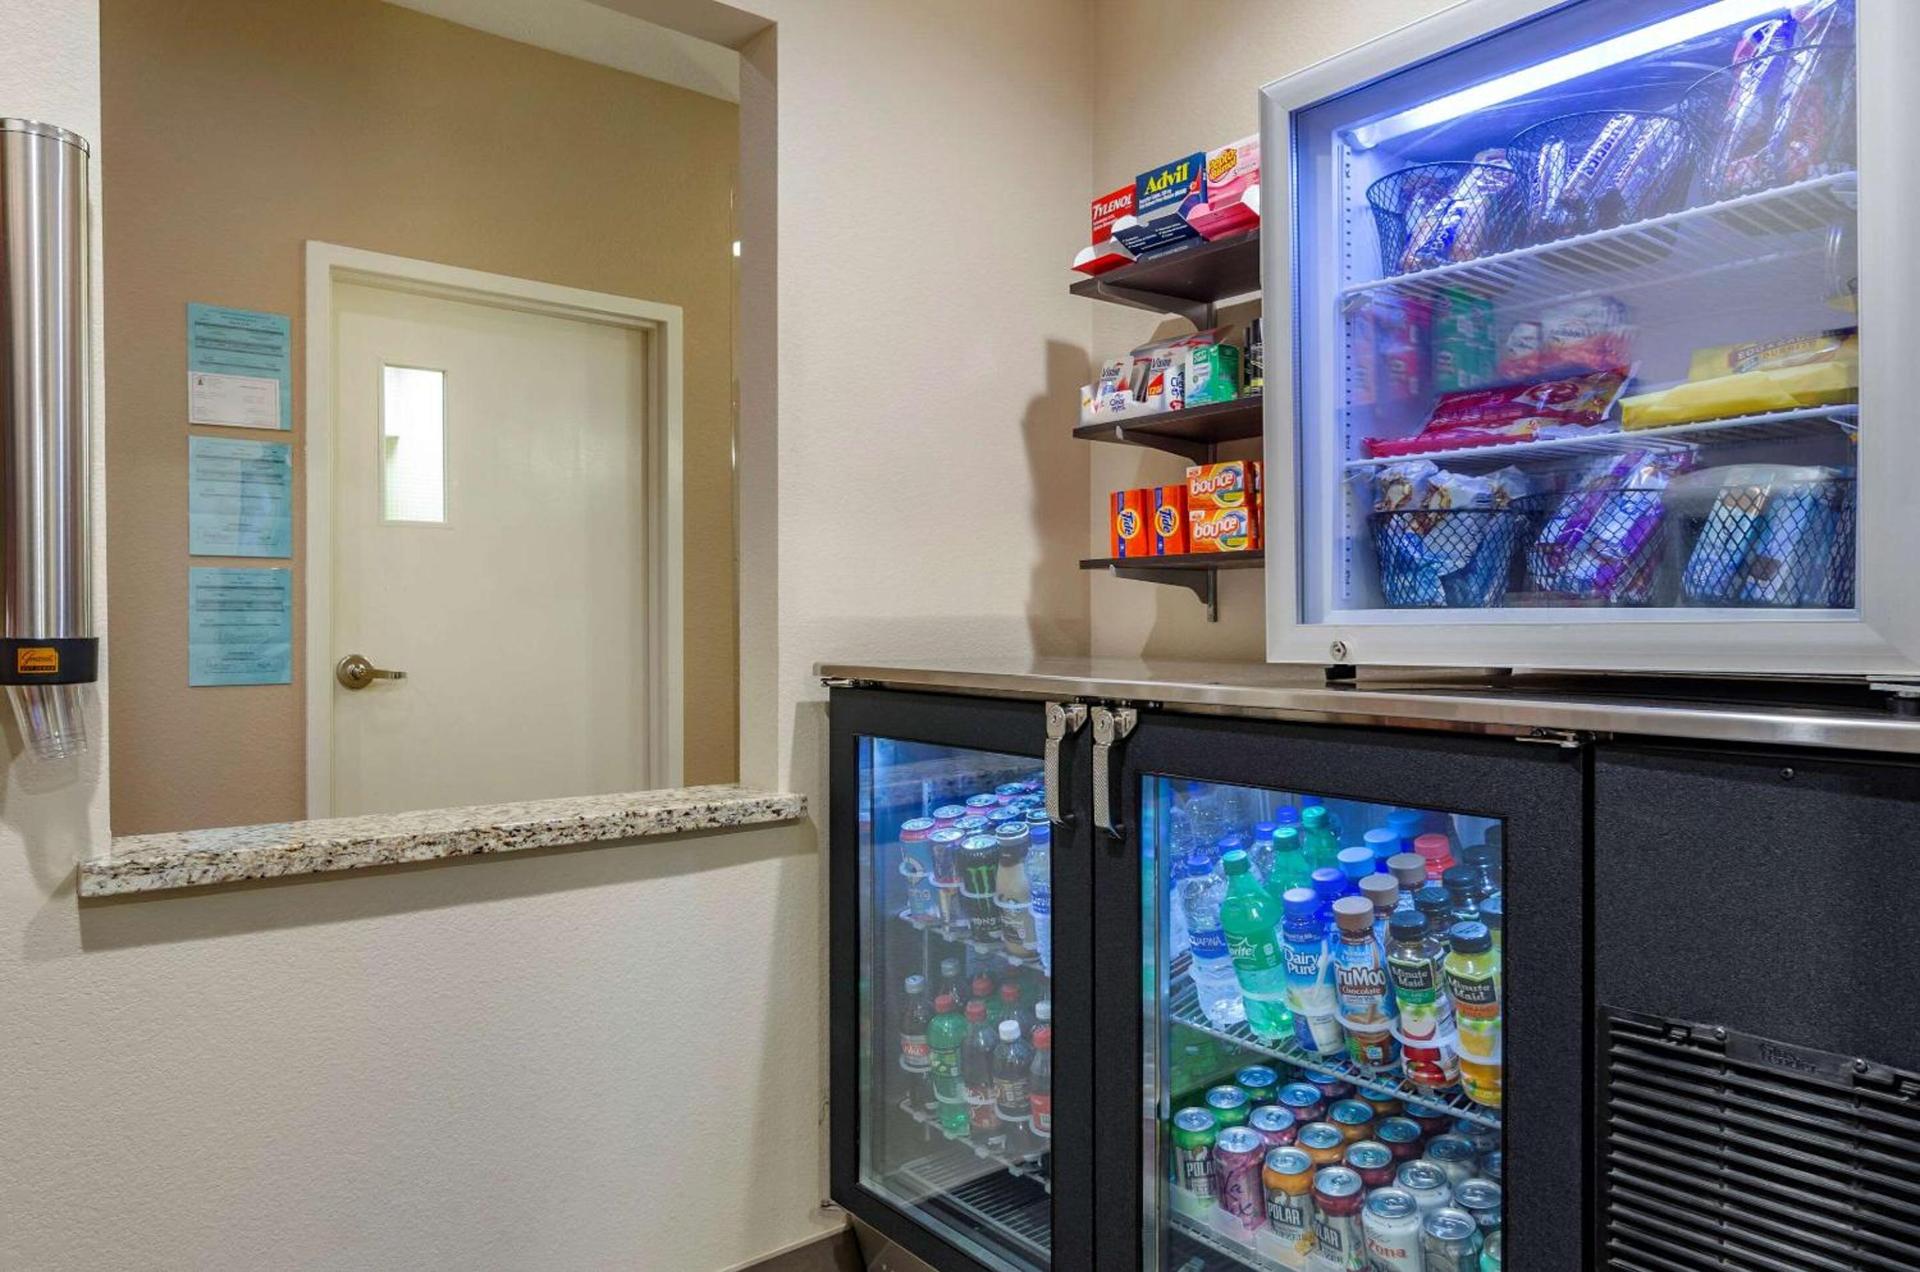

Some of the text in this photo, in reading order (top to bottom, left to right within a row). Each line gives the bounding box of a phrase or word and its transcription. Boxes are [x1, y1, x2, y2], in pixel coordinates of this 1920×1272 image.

[1145, 162, 1190, 195] Advil
[1093, 193, 1132, 220] TYLENOL
[1191, 470, 1235, 495] bounce
[1121, 510, 1136, 535] Tide
[1158, 507, 1173, 533] Tide
[1194, 516, 1239, 539] bounce
[1284, 949, 1317, 966] Dairy
[1287, 961, 1317, 975] Pure
[1398, 975, 1424, 987] Maid
[1454, 987, 1485, 1000] Maid
[1186, 1161, 1213, 1177] POLA
[1268, 1202, 1300, 1227] POLAR
[1316, 1223, 1339, 1249] LAR
